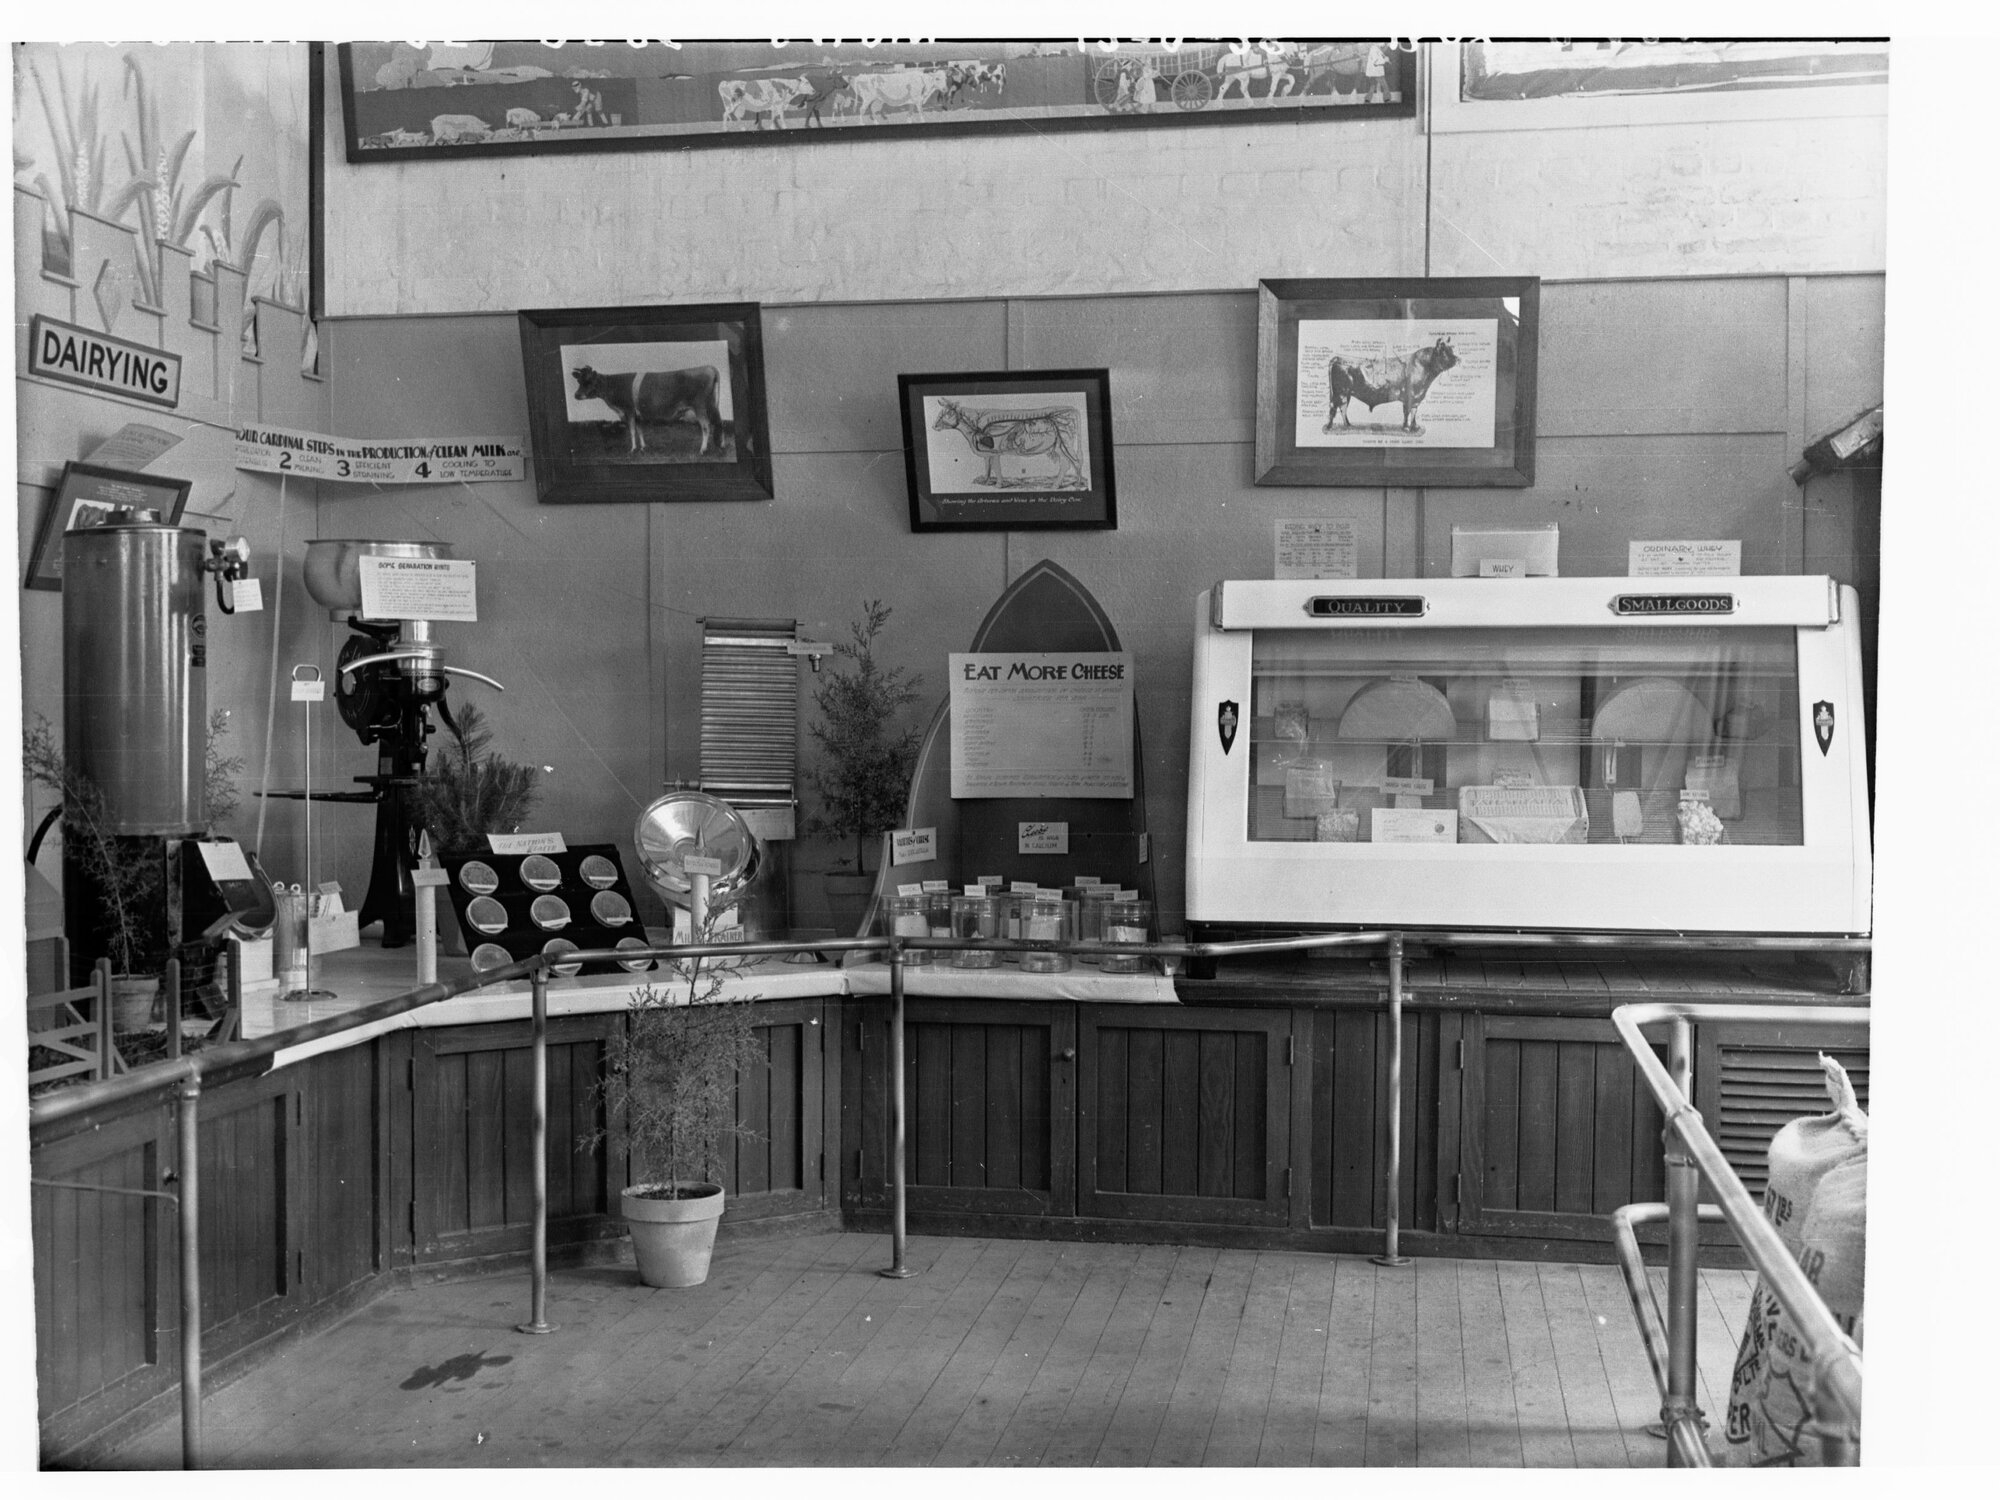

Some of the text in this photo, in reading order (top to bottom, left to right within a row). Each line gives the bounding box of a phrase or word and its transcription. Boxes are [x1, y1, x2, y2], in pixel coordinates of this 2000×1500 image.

[43, 330, 168, 394] DAIRYING
[259, 431, 304, 450] CARDINAL
[306, 438, 335, 455] STEPS
[336, 448, 345, 457] IN
[362, 446, 426, 460] PRODUCTION
[436, 445, 467, 459] CLEAN
[472, 444, 506, 457] MILK
[279, 451, 292, 470] 2
[337, 459, 351, 477] 3
[442, 459, 495, 468] COOLING TO
[415, 462, 432, 478] 4
[460, 469, 512, 477] TEMPERATURE
[1643, 545, 1692, 553] ORDINARY
[1328, 600, 1405, 614] QUALITY
[1622, 598, 1729, 611] SMALLGOODS
[964, 662, 1124, 680] EAT MORE CHEESE
